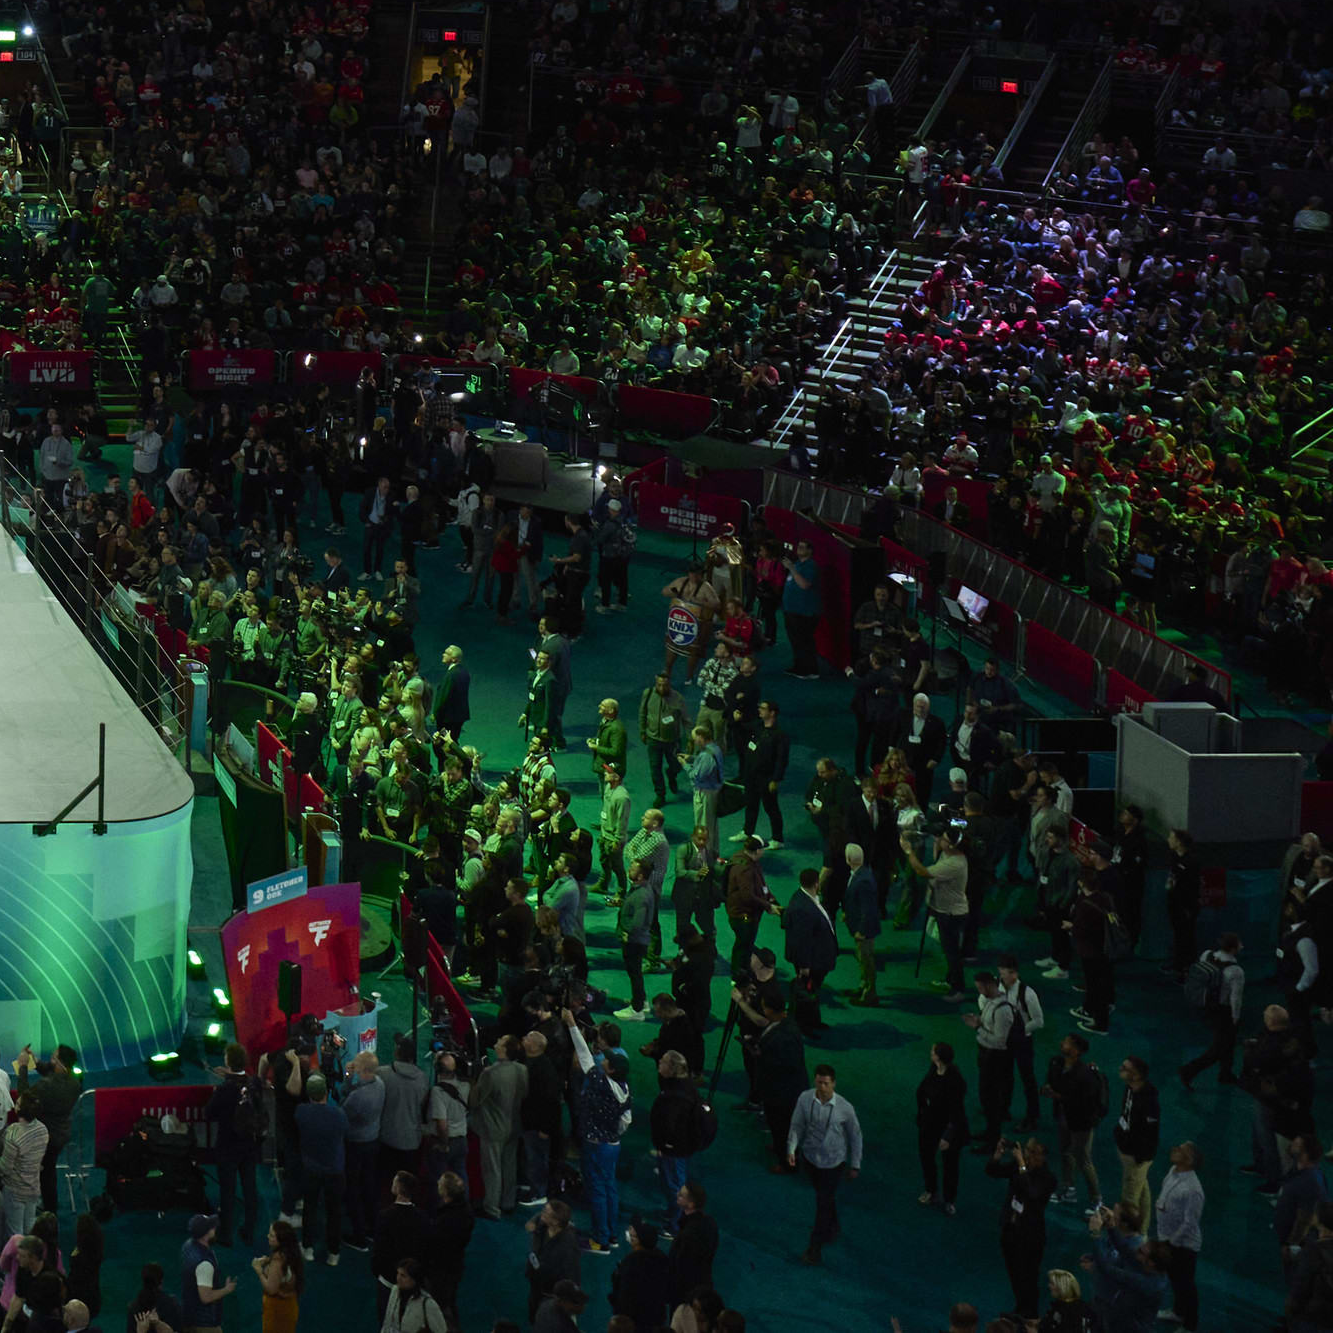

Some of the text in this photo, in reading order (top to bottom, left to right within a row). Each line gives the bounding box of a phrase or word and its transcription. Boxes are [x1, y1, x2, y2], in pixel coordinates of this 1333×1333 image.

[29, 369, 76, 383] LVII
[1128, 425, 1143, 438] 10
[669, 618, 694, 634] KNIX
[252, 889, 264, 905] 9
